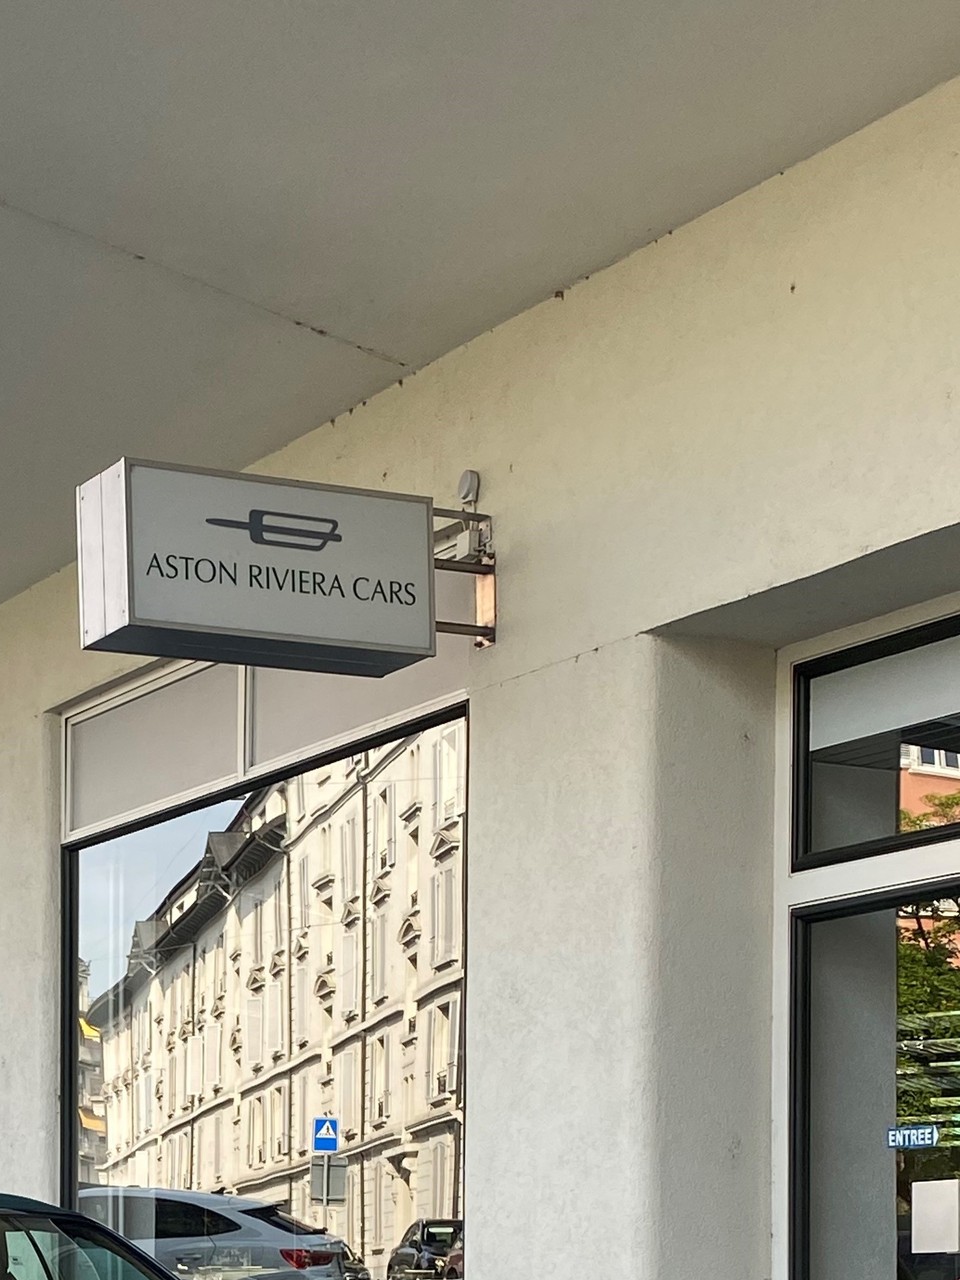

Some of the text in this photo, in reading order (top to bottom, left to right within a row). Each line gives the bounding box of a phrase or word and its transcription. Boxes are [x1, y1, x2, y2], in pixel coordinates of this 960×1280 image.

[145, 552, 417, 607] ASTON RIVIERA CARS
[888, 1128, 933, 1147] ENTREE
